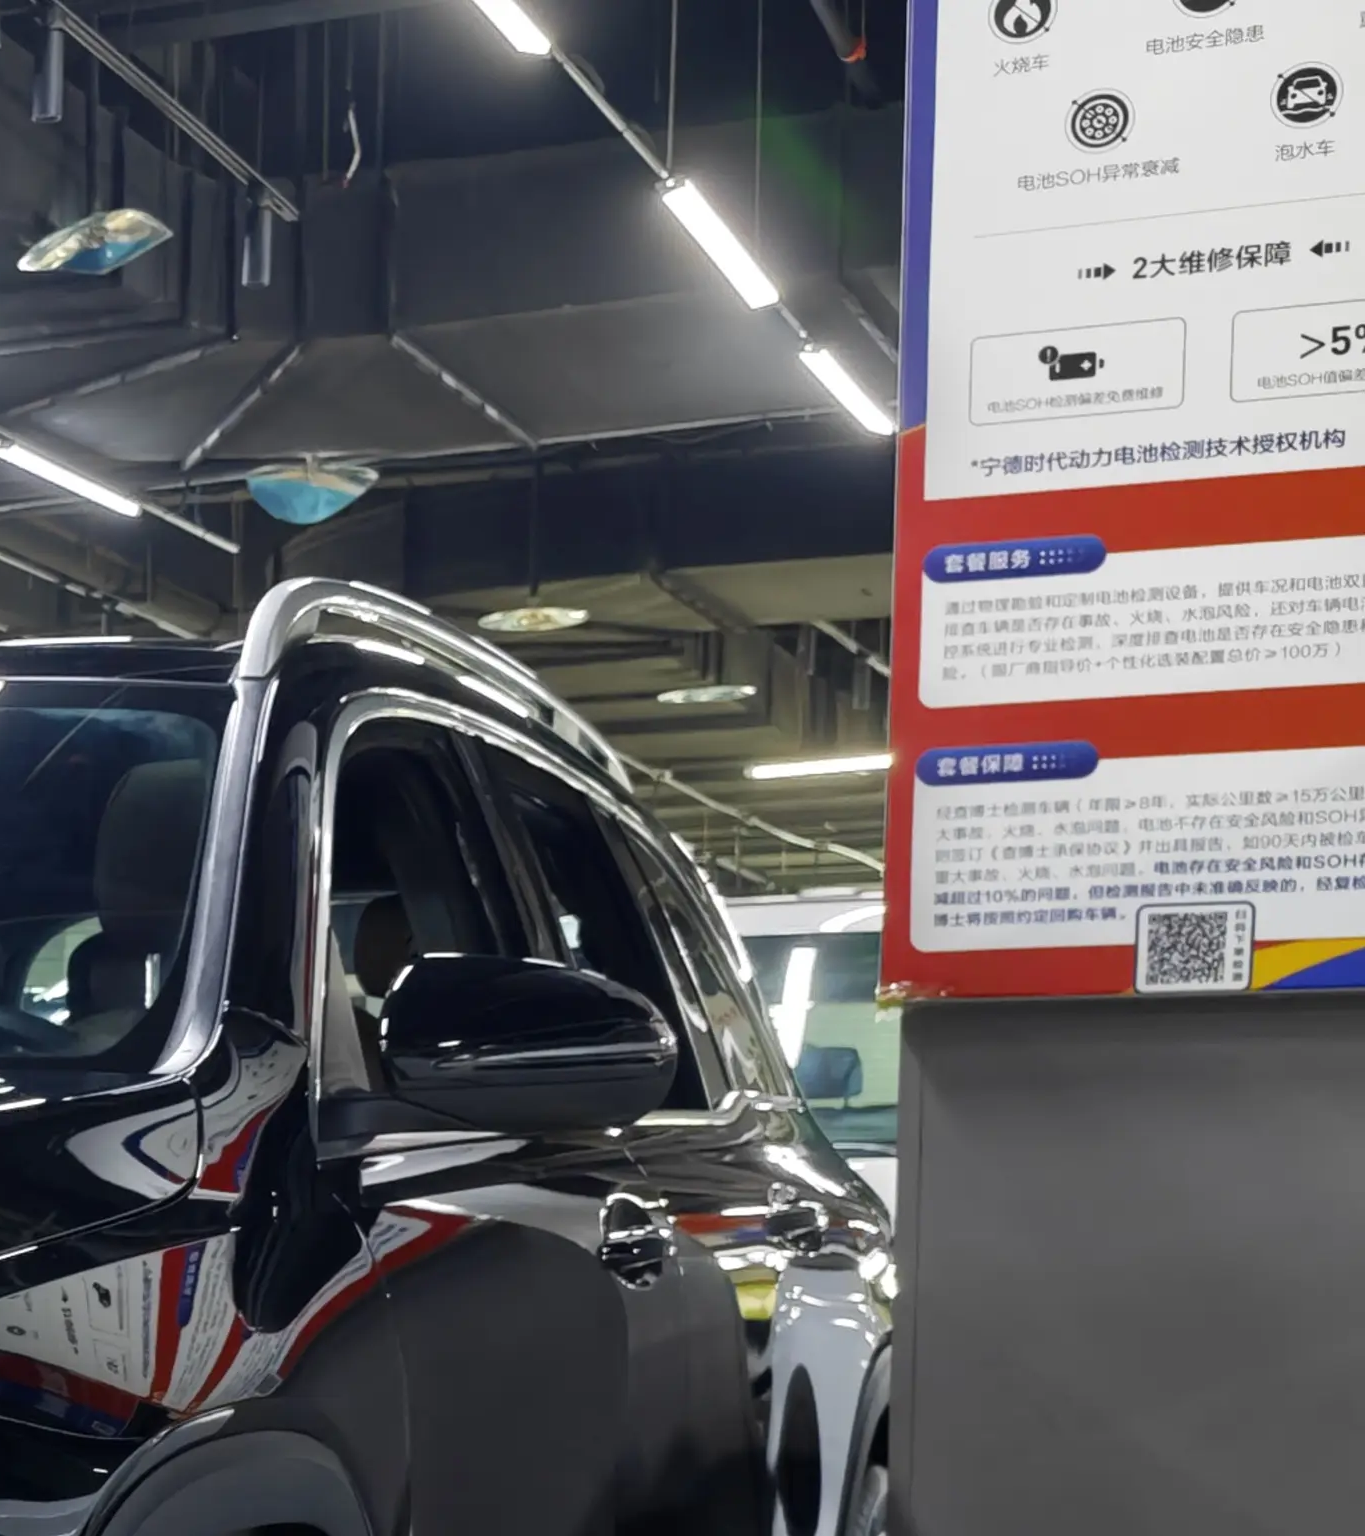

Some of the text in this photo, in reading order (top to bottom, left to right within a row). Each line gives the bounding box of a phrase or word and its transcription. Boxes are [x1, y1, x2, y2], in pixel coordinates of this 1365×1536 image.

[1144, 24, 1265, 55] 电池安全隐患
[992, 52, 1050, 77] 火烧车
[1274, 138, 1336, 162] 泡水车
[1016, 156, 1181, 192] 电池SOH异常衰减
[1131, 240, 1292, 280] 2大维修保障
[1299, 323, 1365, 360] >5
[943, 548, 1033, 574] 套餐服务
[936, 753, 1025, 777] 套餐保障
